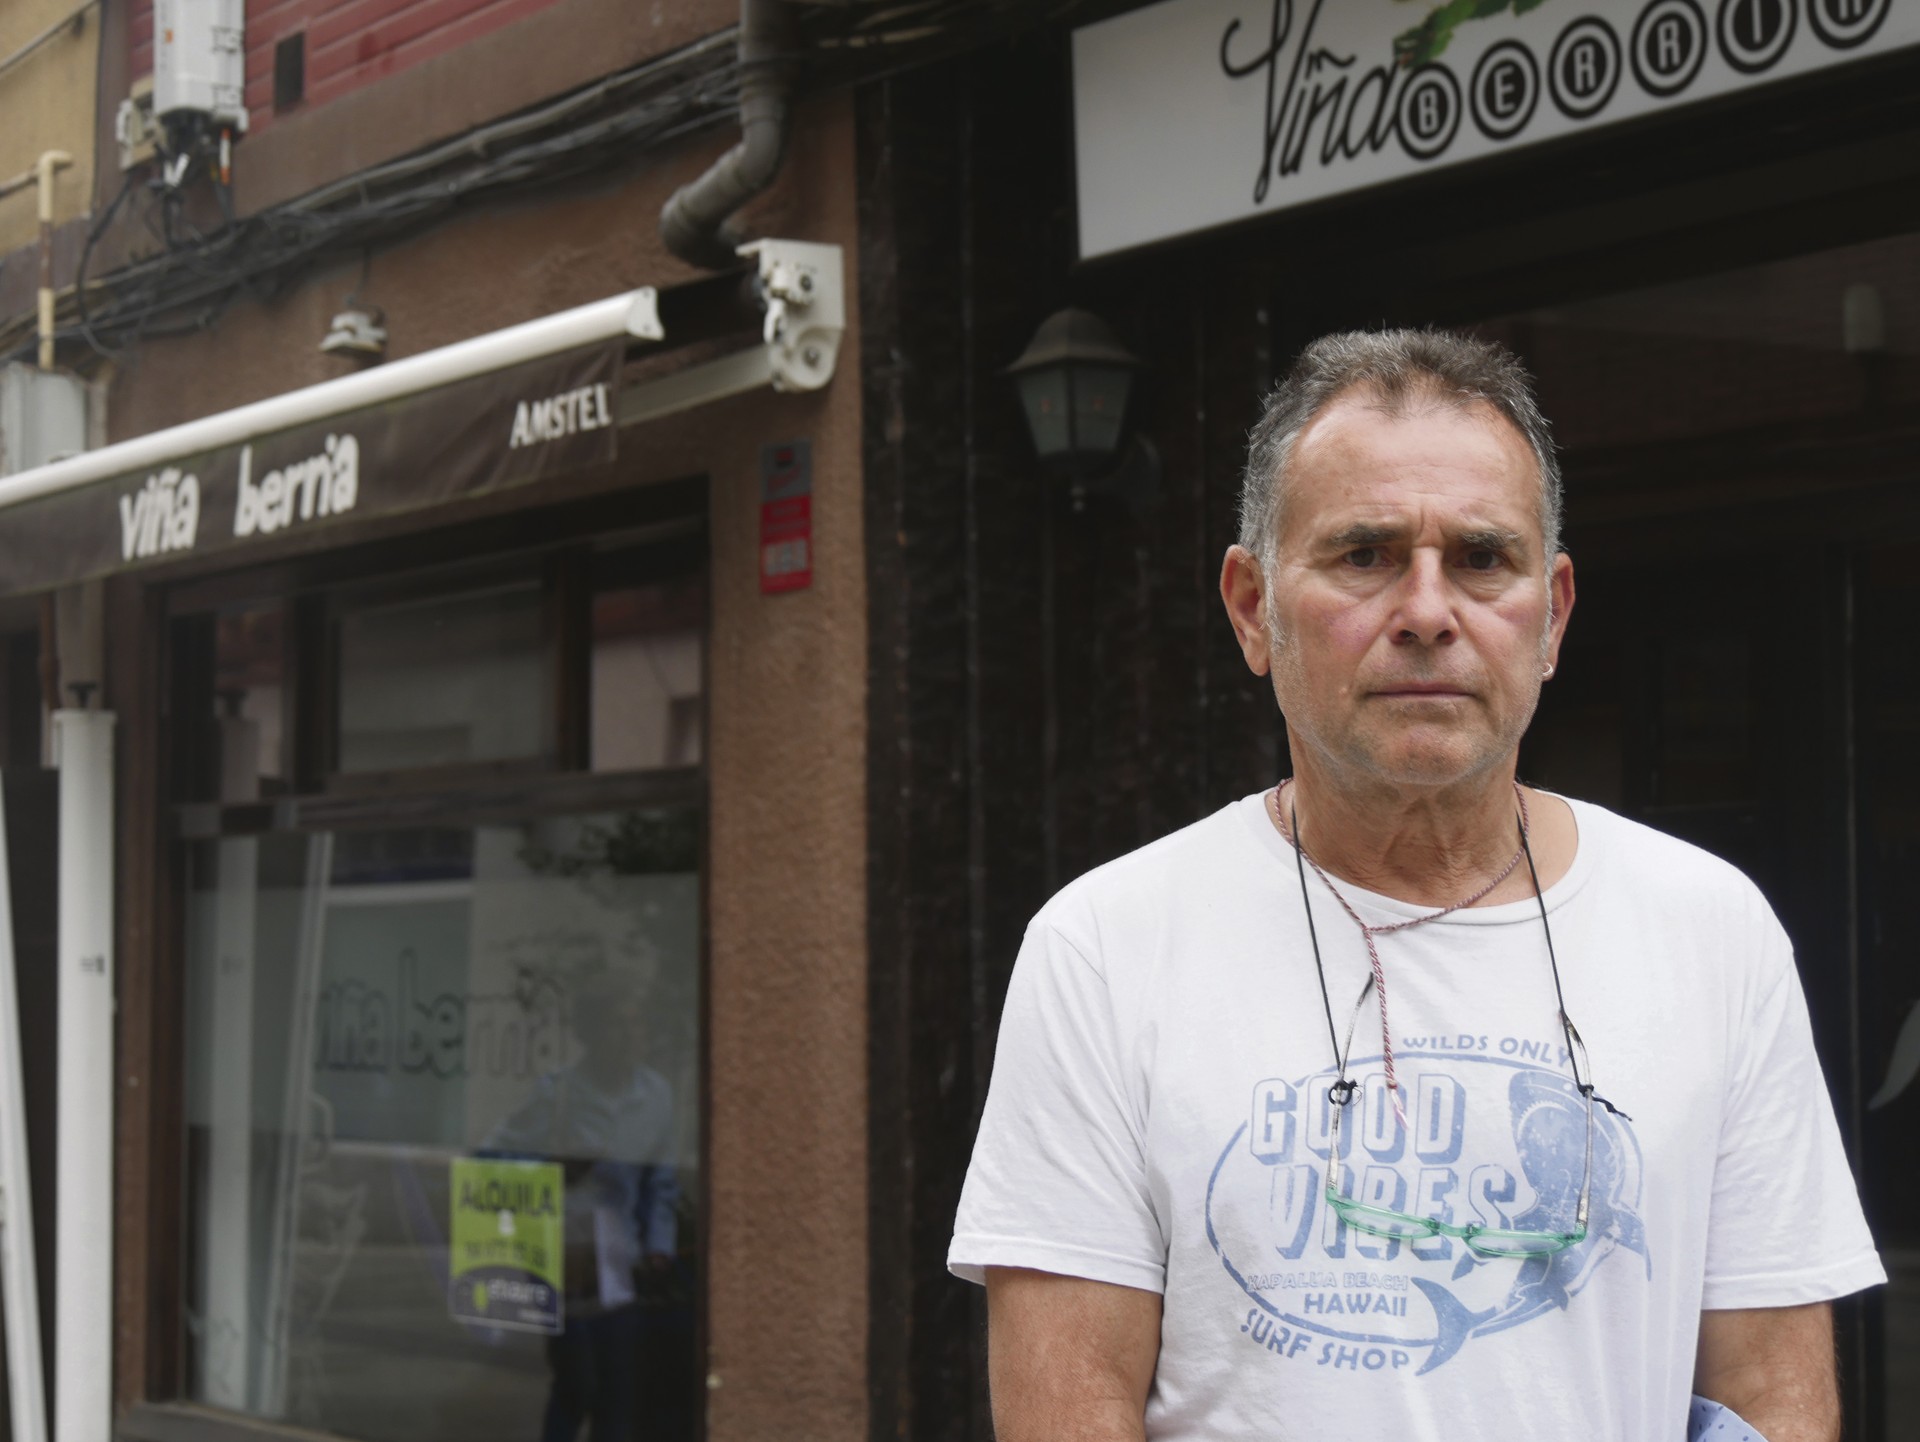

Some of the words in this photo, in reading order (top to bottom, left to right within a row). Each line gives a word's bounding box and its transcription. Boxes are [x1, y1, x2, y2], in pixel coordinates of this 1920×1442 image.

[509, 382, 612, 449] AMSTEL
[119, 467, 200, 561] viña
[233, 433, 359, 537] berria
[1402, 1034, 1489, 1050] WILDS
[1499, 1037, 1571, 1068] ONLY
[1249, 1073, 1467, 1165] GOOD
[458, 1178, 557, 1218] ALQUILA
[1271, 1163, 1517, 1266] VIBES
[1247, 1272, 1338, 1292] KAPALUA
[1343, 1272, 1410, 1292] BEACH
[1303, 1292, 1408, 1317] HAWAII
[1240, 1308, 1313, 1359] SURF
[1317, 1342, 1411, 1371] SHOP
